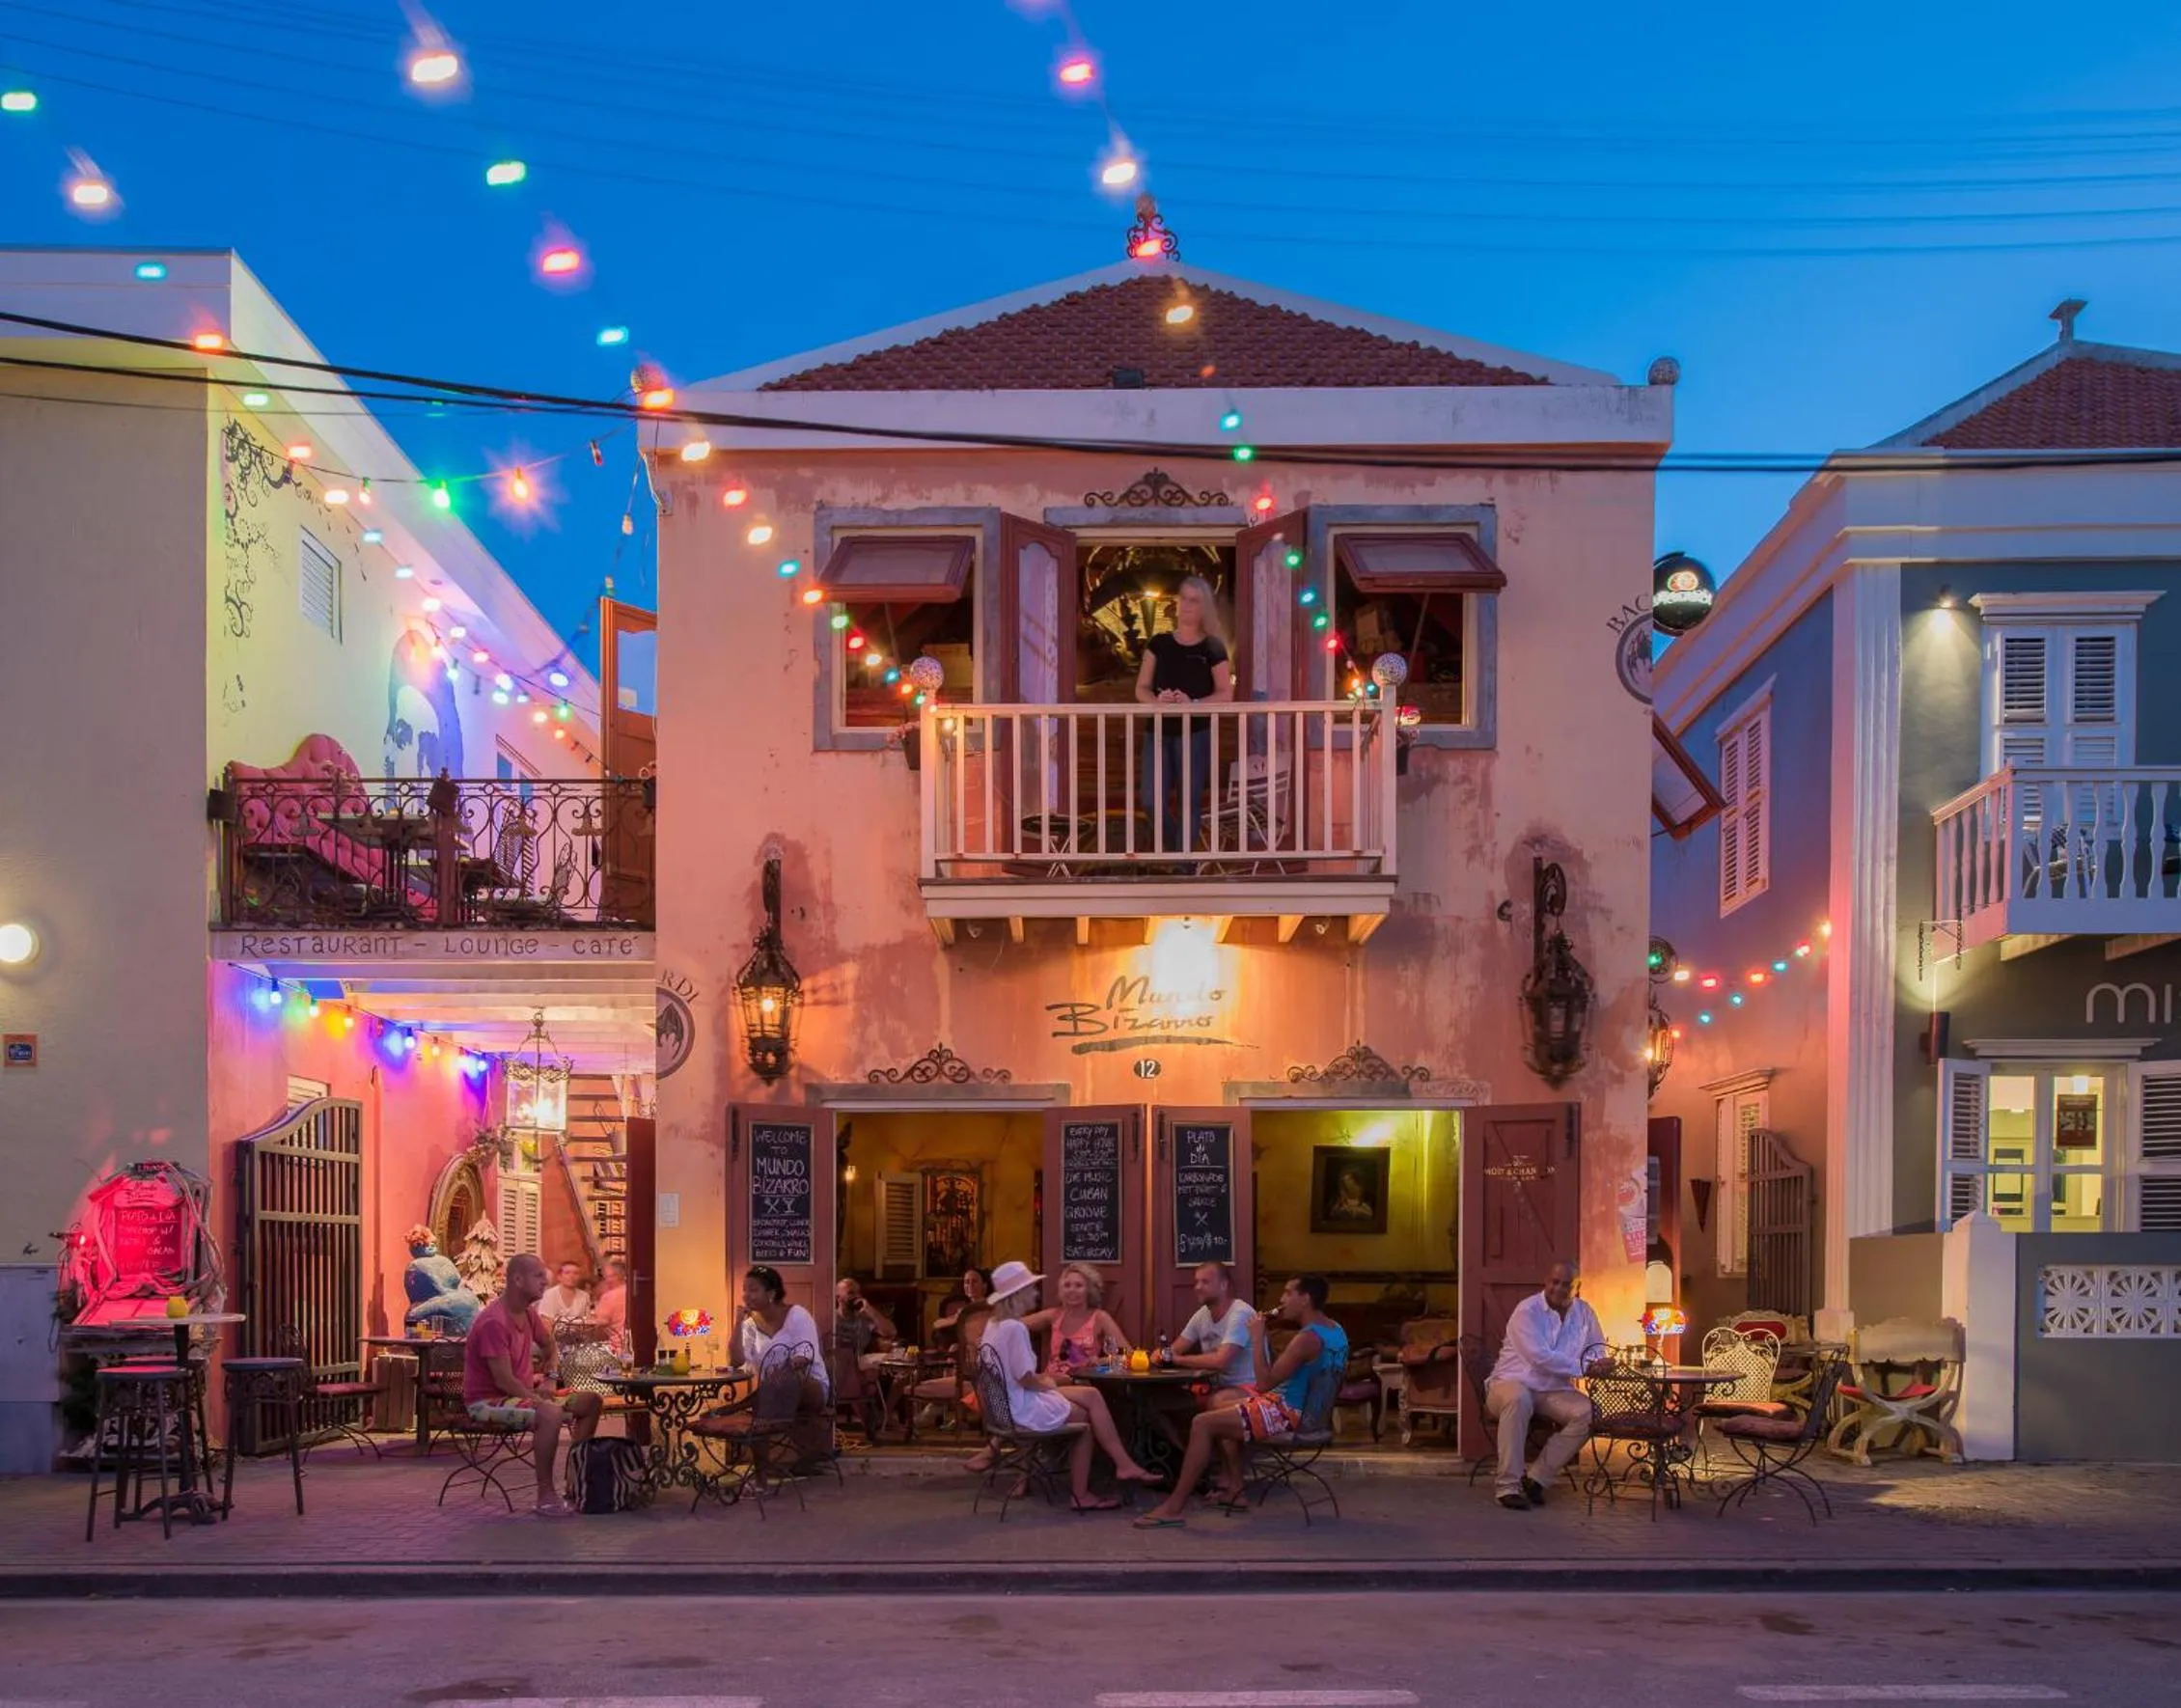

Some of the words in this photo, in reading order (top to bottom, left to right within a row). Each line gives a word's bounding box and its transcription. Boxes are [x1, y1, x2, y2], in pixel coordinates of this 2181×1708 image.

[1106, 975, 1226, 1010] Mundo
[1140, 1061, 1155, 1078] 12
[755, 1130, 808, 1143] WELCOME
[1187, 1131, 1215, 1143] PLATO
[770, 1145, 788, 1155] TO
[757, 1158, 805, 1176] MUNDO
[753, 1175, 809, 1195] BIZARRO
[1069, 1187, 1108, 1201] CUBAN
[1065, 1205, 1108, 1219] GROOVE
